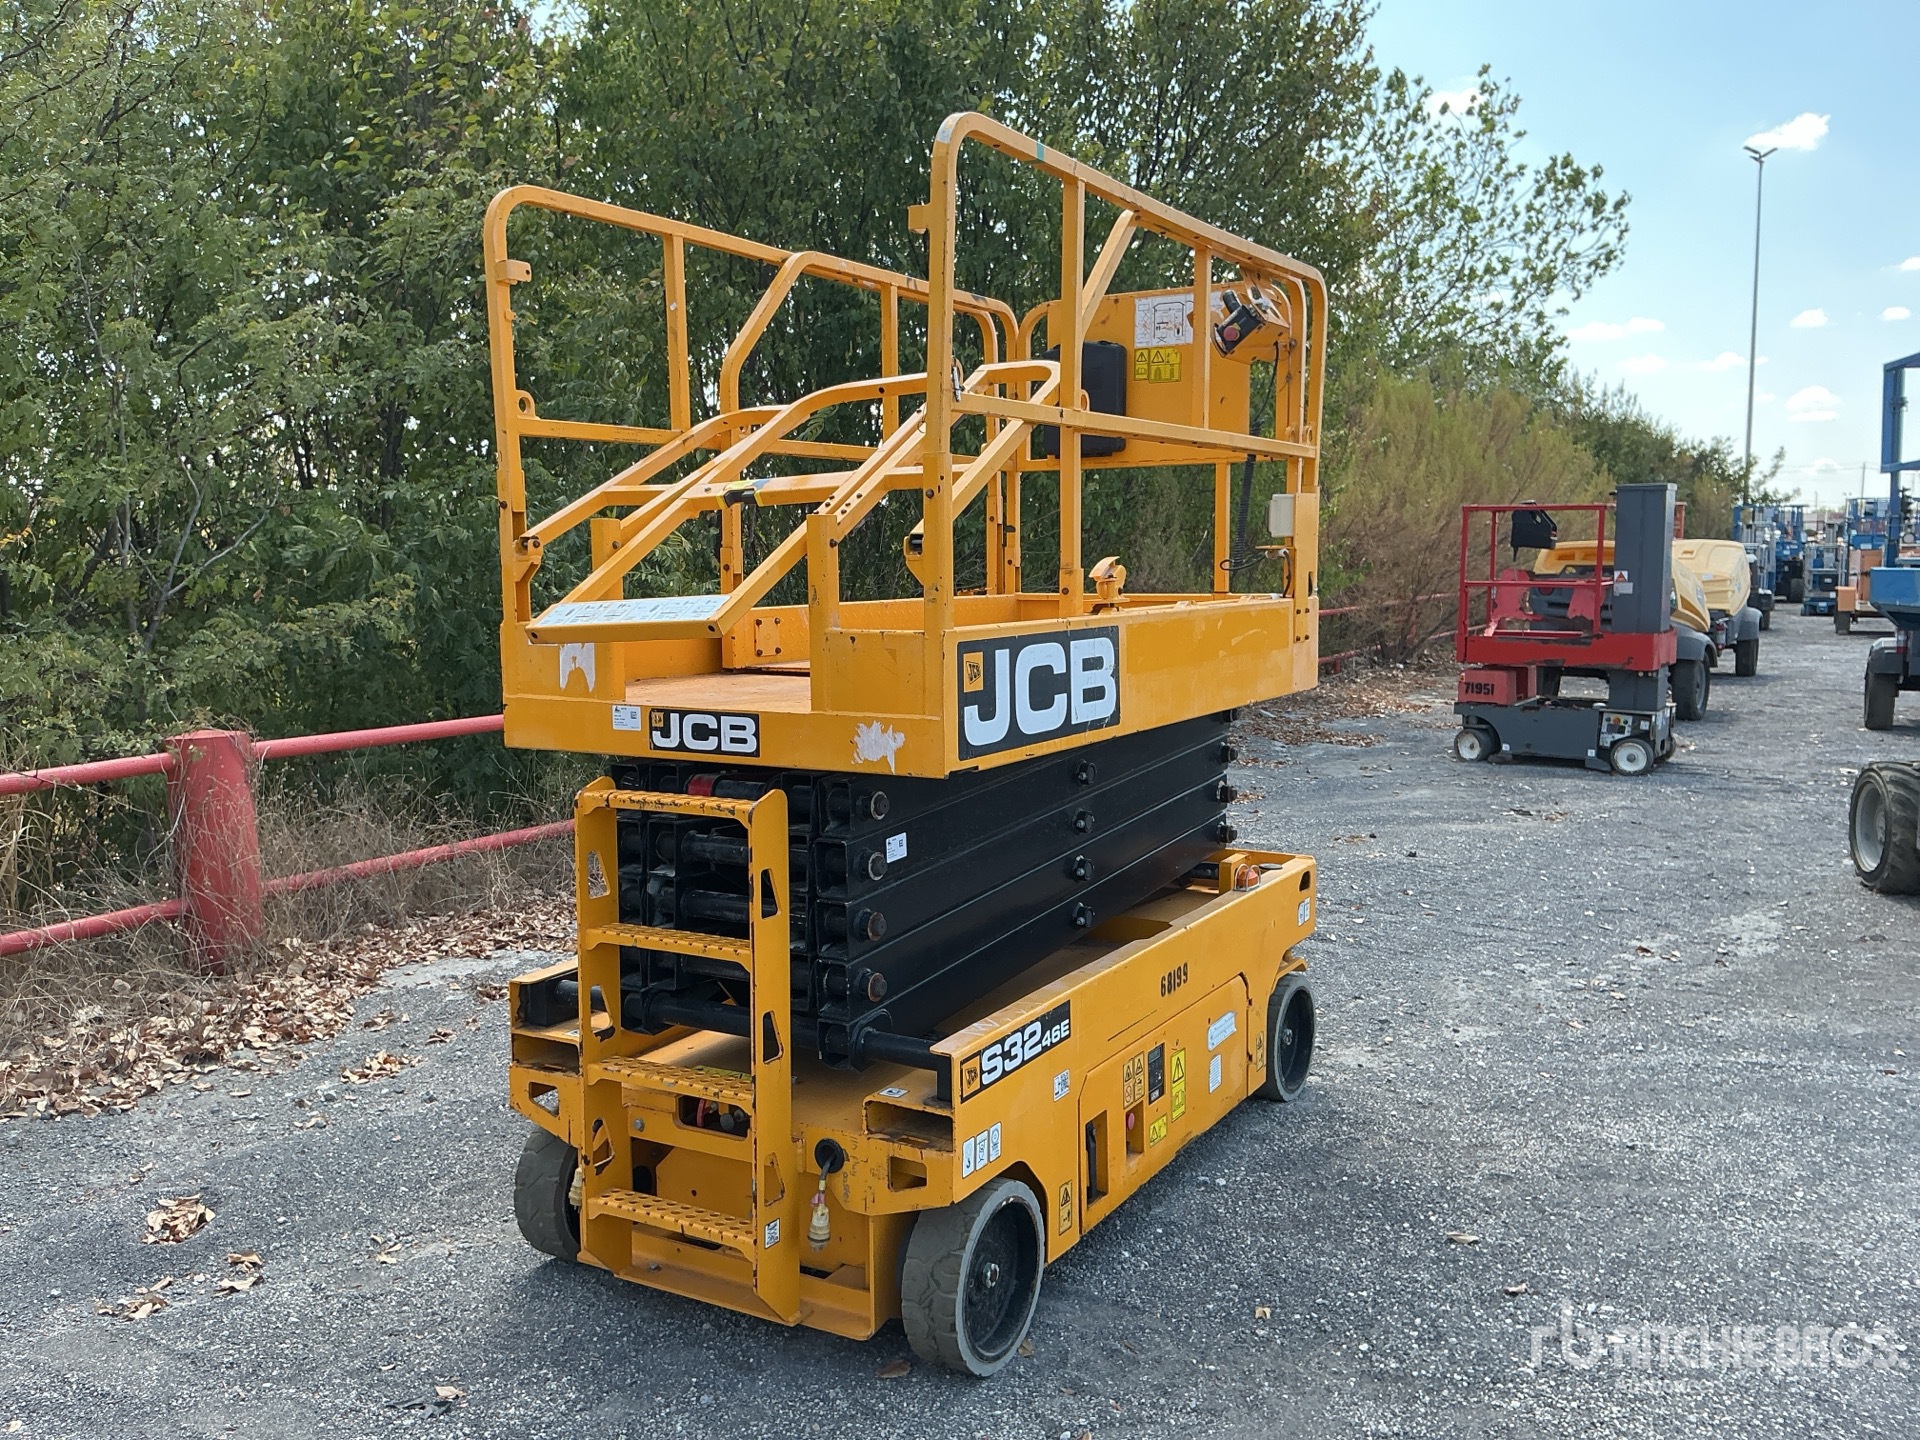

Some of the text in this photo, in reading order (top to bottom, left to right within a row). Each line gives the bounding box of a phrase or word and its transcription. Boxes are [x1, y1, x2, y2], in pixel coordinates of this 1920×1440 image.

[964, 637, 1117, 746] JCB
[1465, 682, 1495, 696] 71951
[652, 713, 757, 753] JCB
[1161, 962, 1188, 997] 68199
